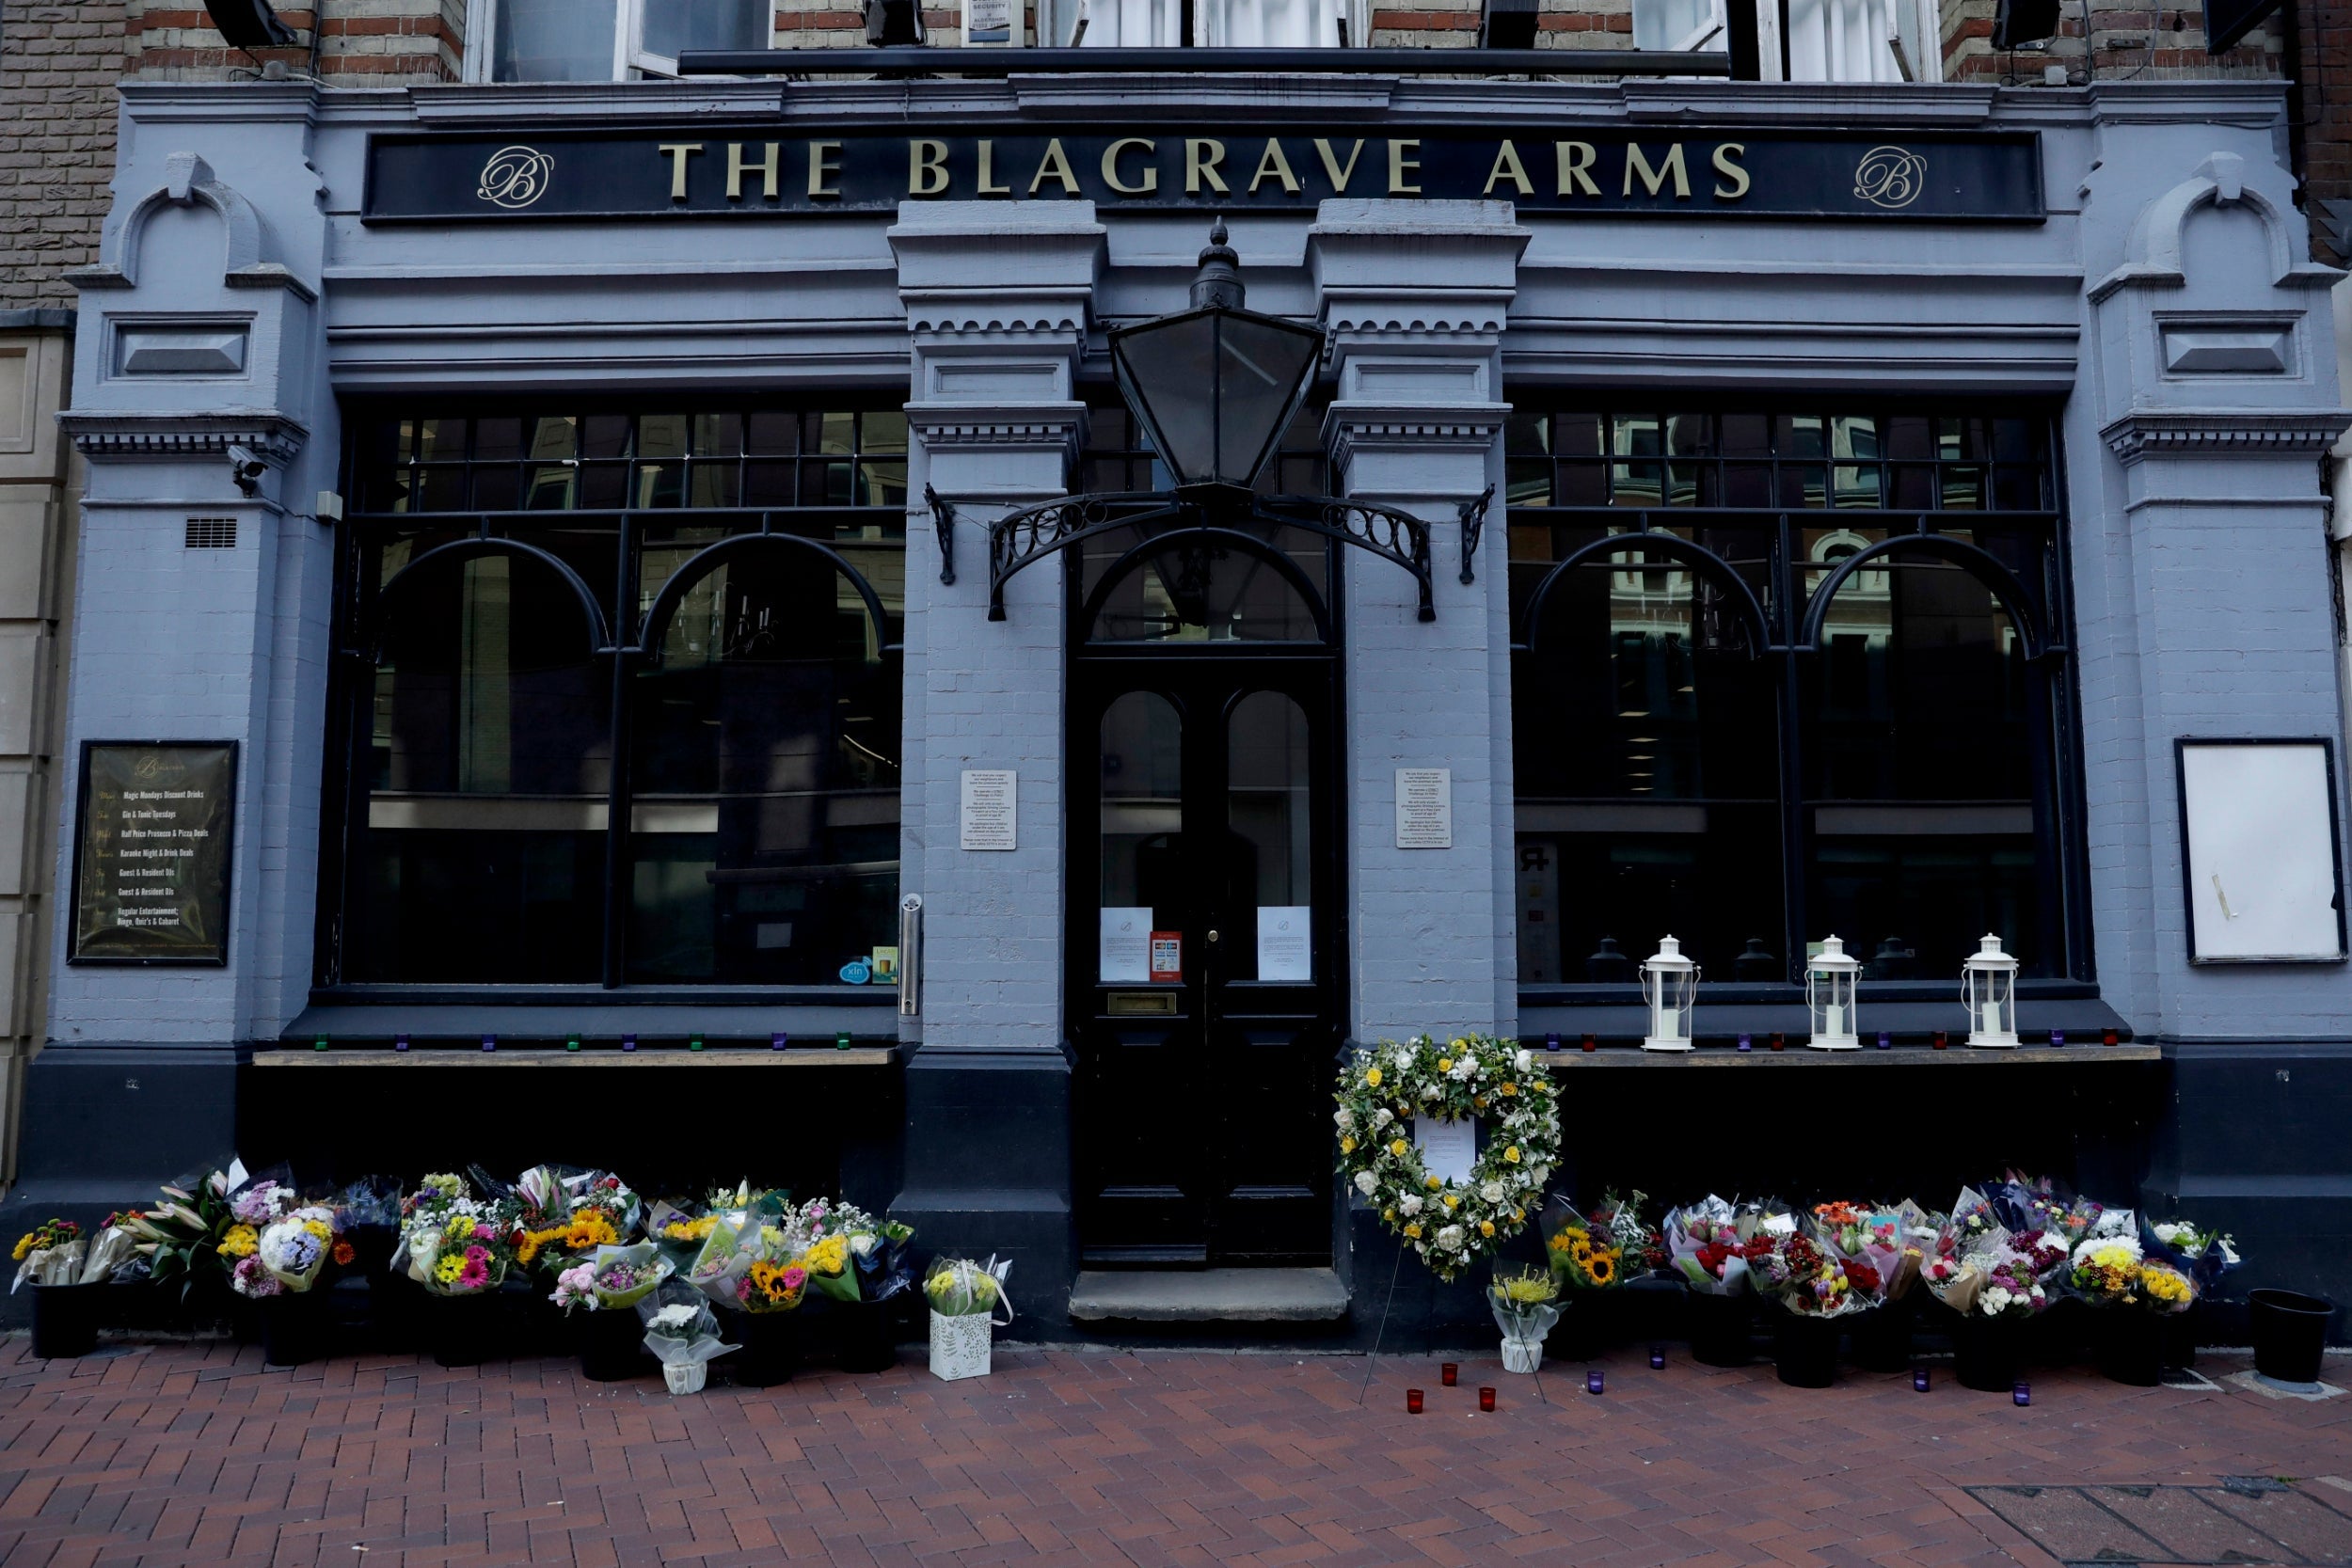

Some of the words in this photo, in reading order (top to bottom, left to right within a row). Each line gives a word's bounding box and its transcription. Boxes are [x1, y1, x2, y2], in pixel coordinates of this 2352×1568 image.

[659, 140, 844, 201] THE
[908, 137, 1422, 198] BLAGRAVE
[1482, 138, 1752, 200] ARMS
[123, 791, 139, 800] Magic
[139, 791, 163, 800] Mondays
[164, 790, 185, 799] Discount
[186, 790, 204, 799] Drinks
[122, 811, 131, 819] Gin
[152, 810, 177, 819] Tuesdays
[120, 830, 133, 838] Half
[193, 829, 209, 837] Deals
[142, 849, 158, 859] Night
[164, 848, 178, 857] Drink
[179, 848, 194, 857] Deals
[141, 868, 165, 877] Resident
[166, 868, 175, 877] DJs
[119, 888, 135, 896] Guest
[140, 888, 165, 896] Resident
[118, 908, 138, 916] Regular
[139, 907, 179, 915] Entertainment;
[152, 917, 157, 926] &
[158, 917, 180, 926] Cabaret
